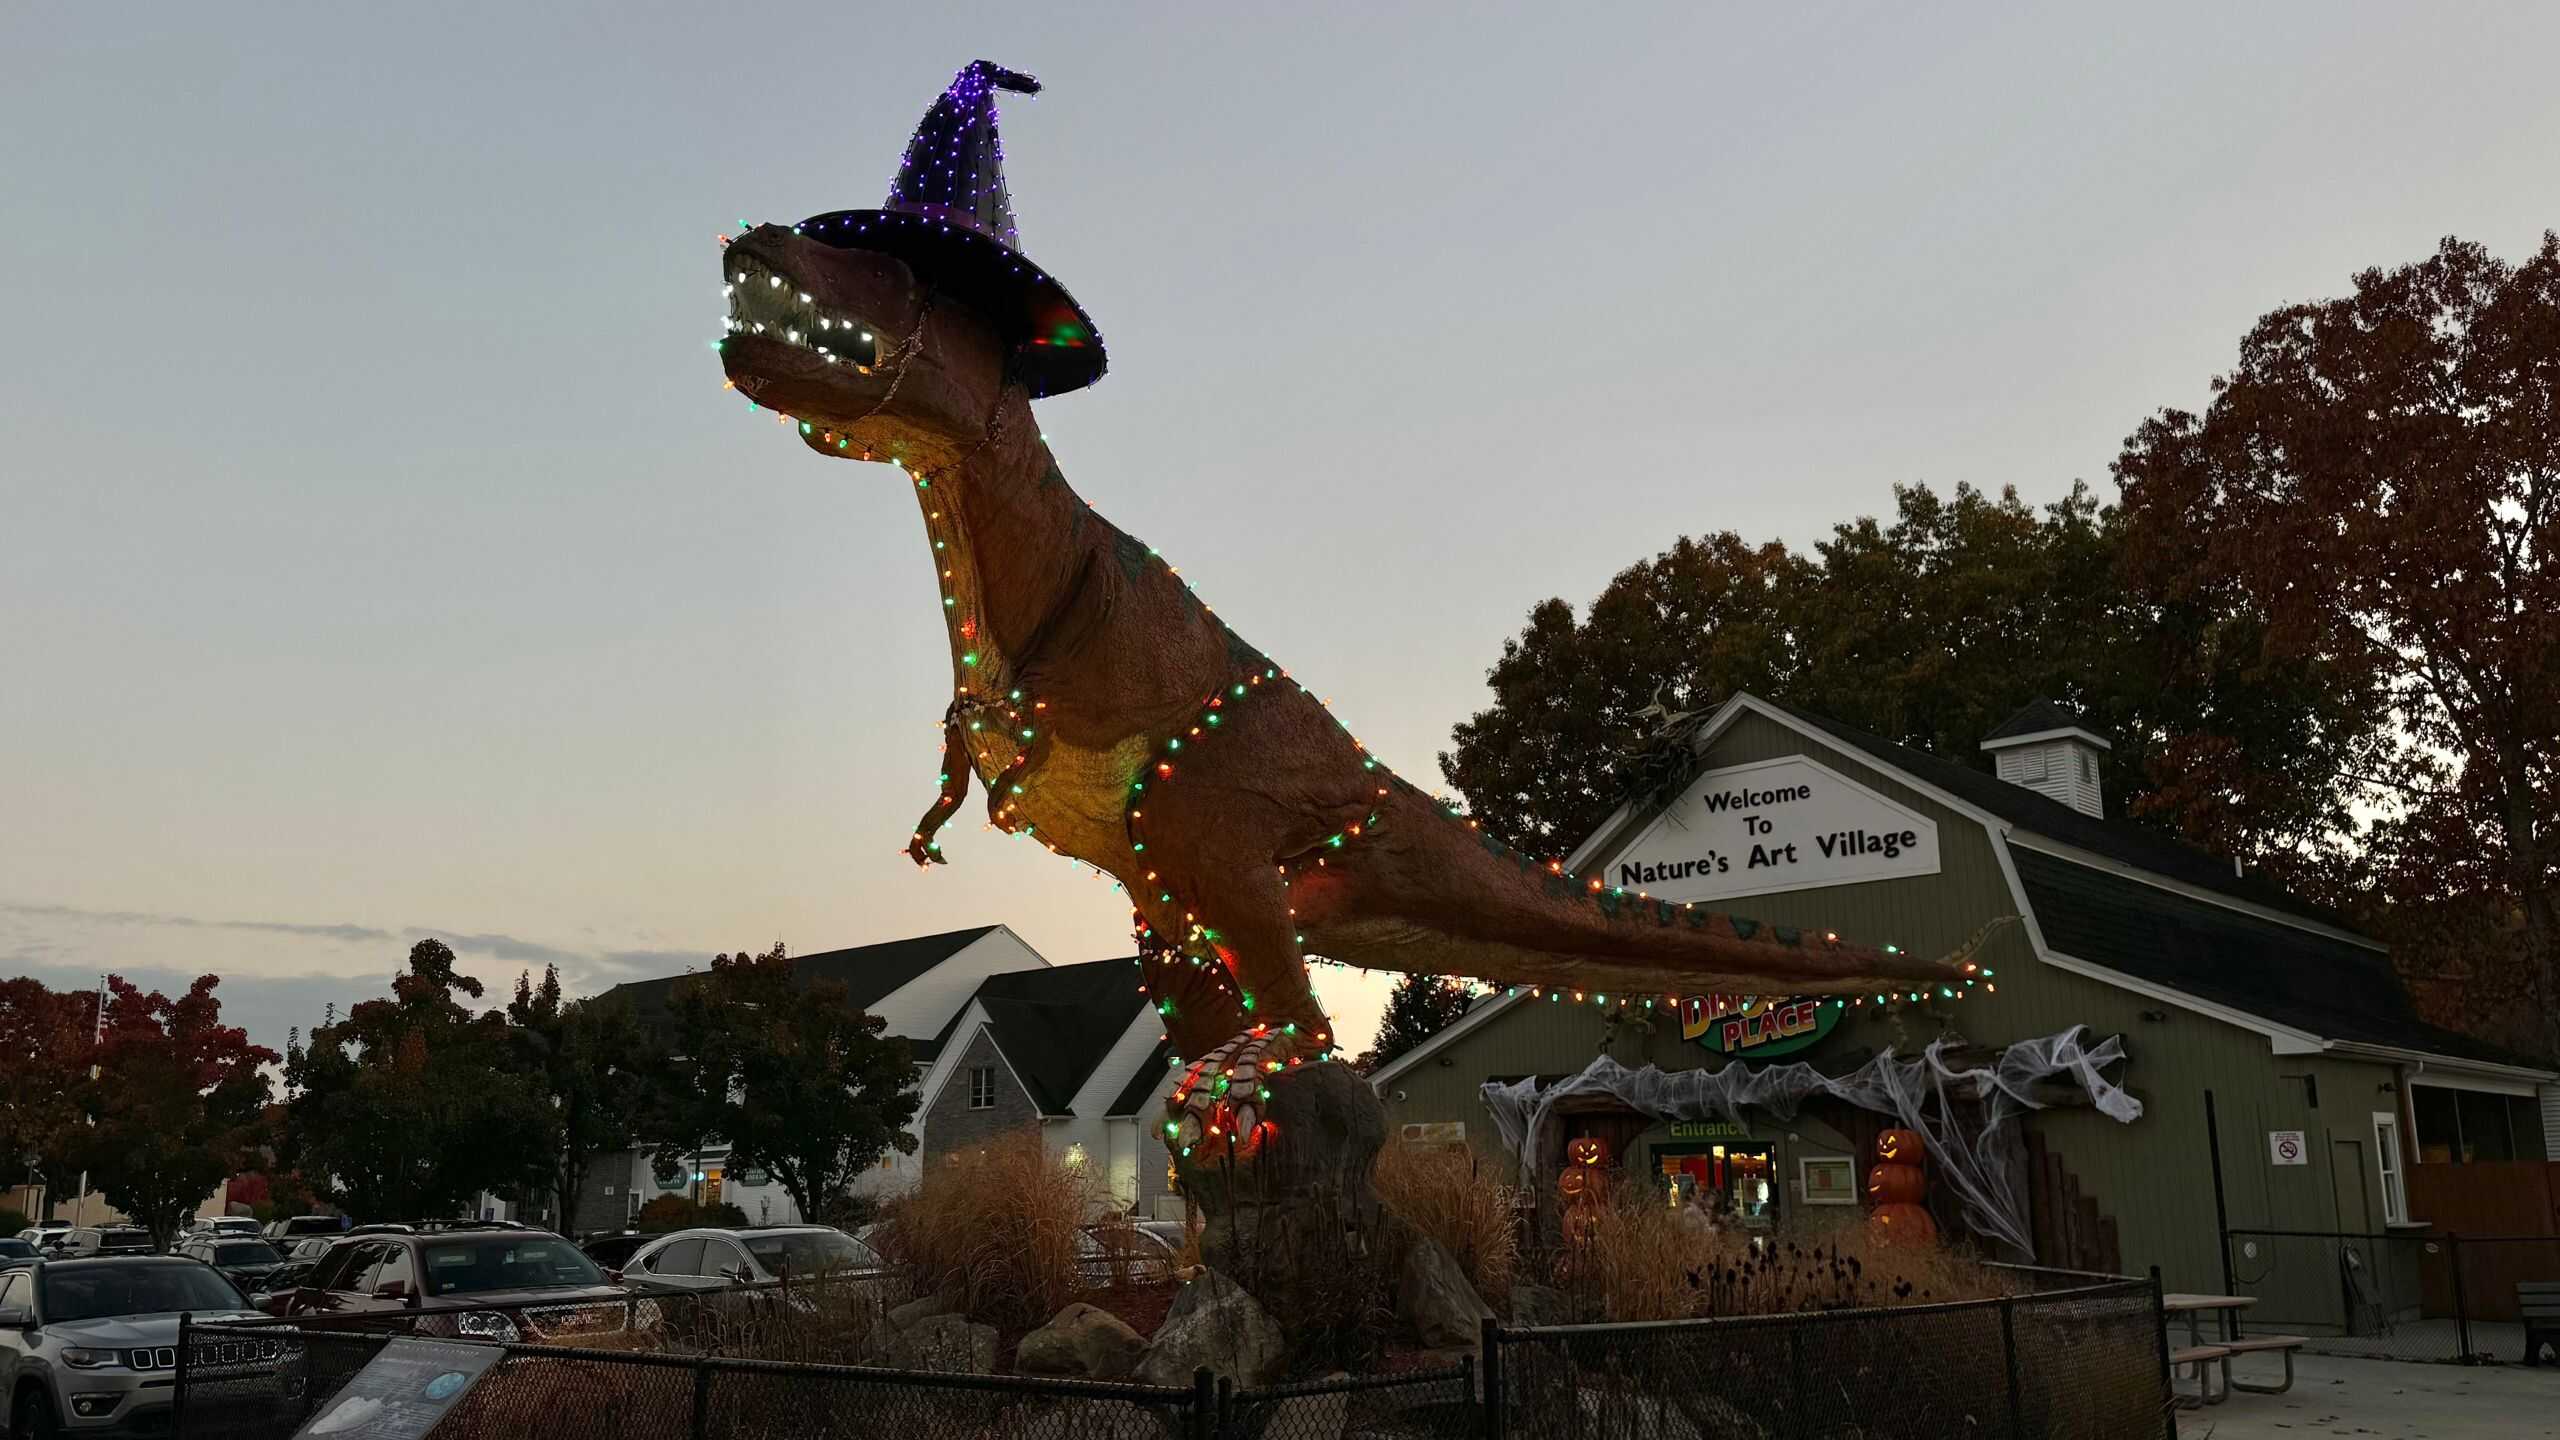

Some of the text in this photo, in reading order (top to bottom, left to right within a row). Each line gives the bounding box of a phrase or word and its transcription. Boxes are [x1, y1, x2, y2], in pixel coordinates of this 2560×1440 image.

[1704, 785, 1811, 813] Welcome
[1743, 816, 1773, 837] To
[1621, 829, 1917, 886] Nature's Art Village
[1723, 1000, 1816, 1052] PLACE
